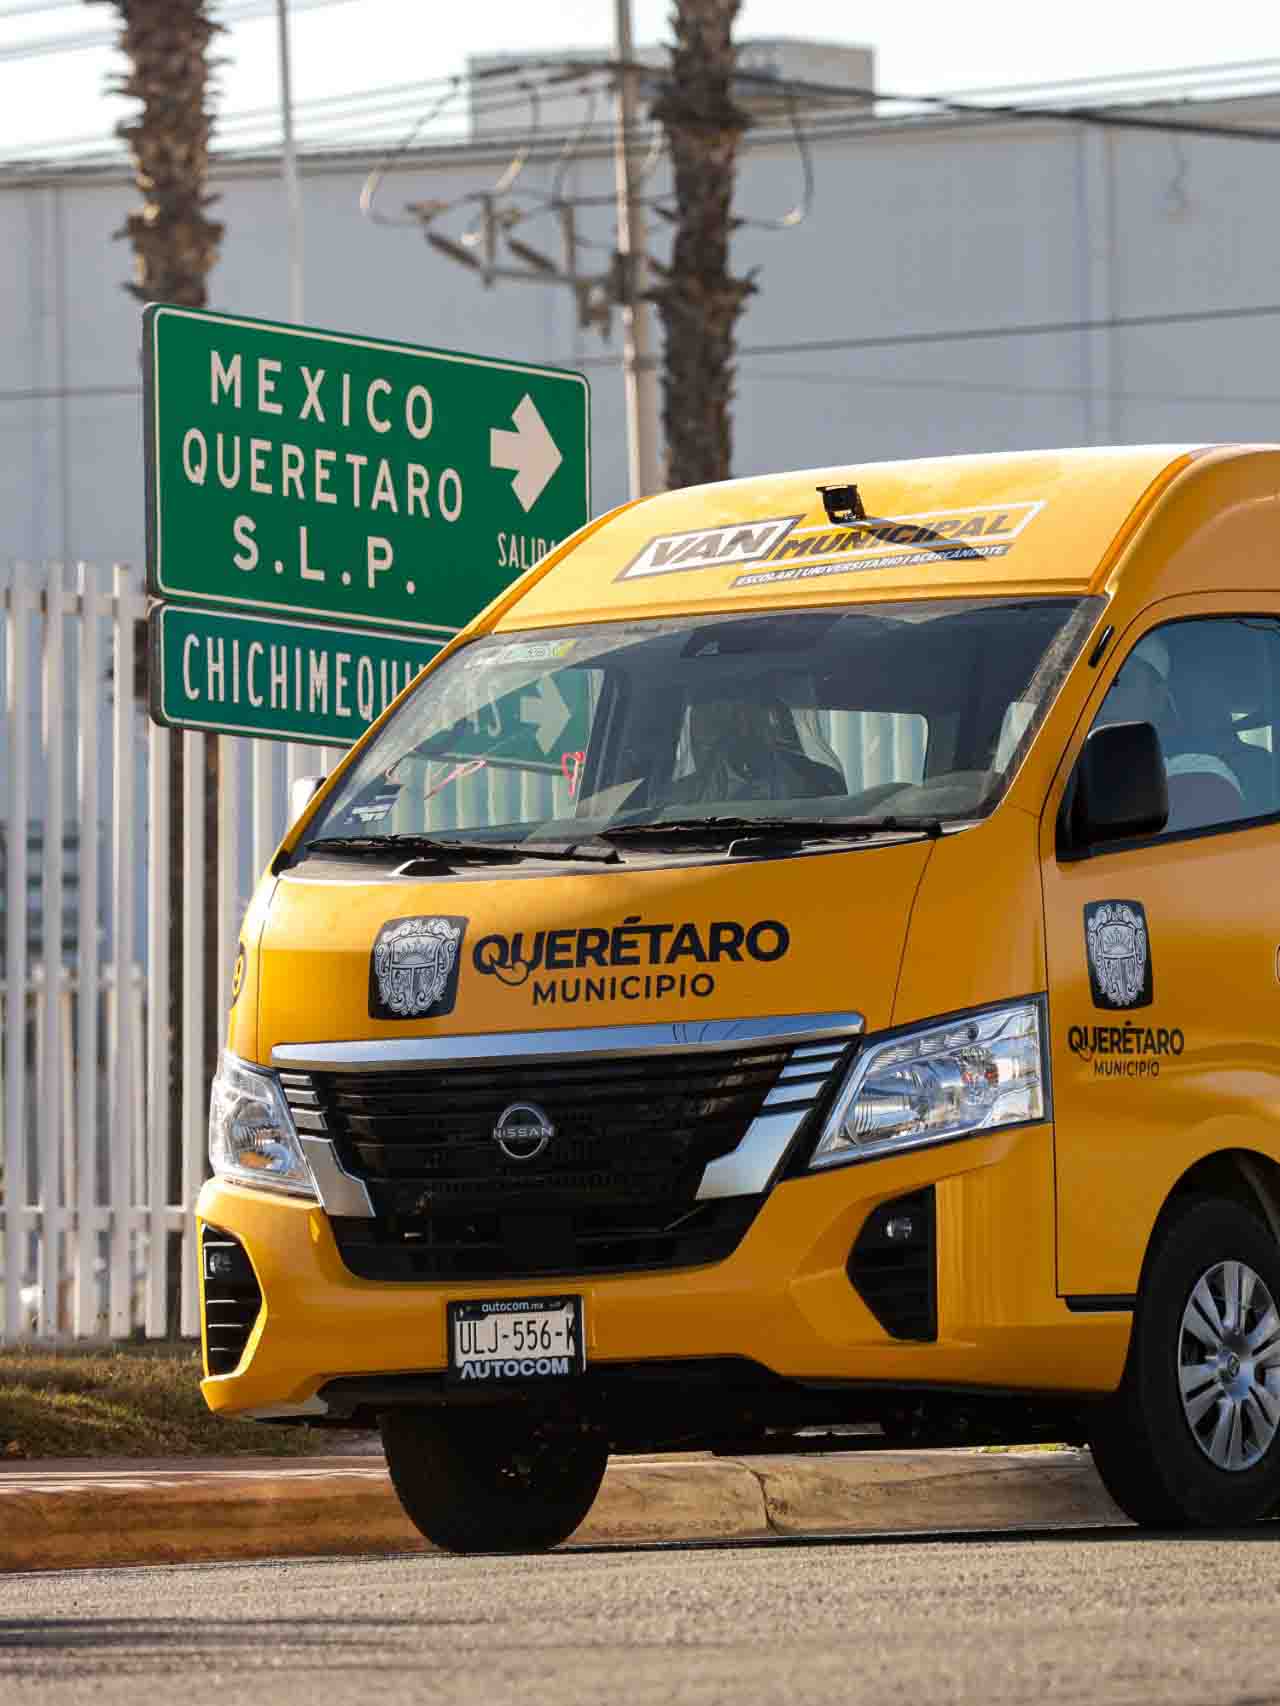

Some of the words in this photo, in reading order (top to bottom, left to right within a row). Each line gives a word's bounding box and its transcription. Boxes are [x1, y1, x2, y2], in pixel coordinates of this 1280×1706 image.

[210, 349, 434, 440] MEXICO
[182, 427, 464, 523] QUERETARO
[232, 514, 416, 595] S.L.P.
[497, 531, 556, 570] SALID
[647, 525, 772, 569] VAN
[772, 513, 1012, 561] MUNICIPAL
[471, 916, 790, 986] QUERÉTARO
[531, 973, 716, 1007] MUNICIPIO
[1067, 1019, 1185, 1063] QUERÉTARO
[1093, 1059, 1161, 1078] MUNICIPIO
[493, 1127, 553, 1139] NISSAN
[459, 1317, 576, 1355] ULJ-556-K
[460, 1357, 569, 1380] AUTOCOM
